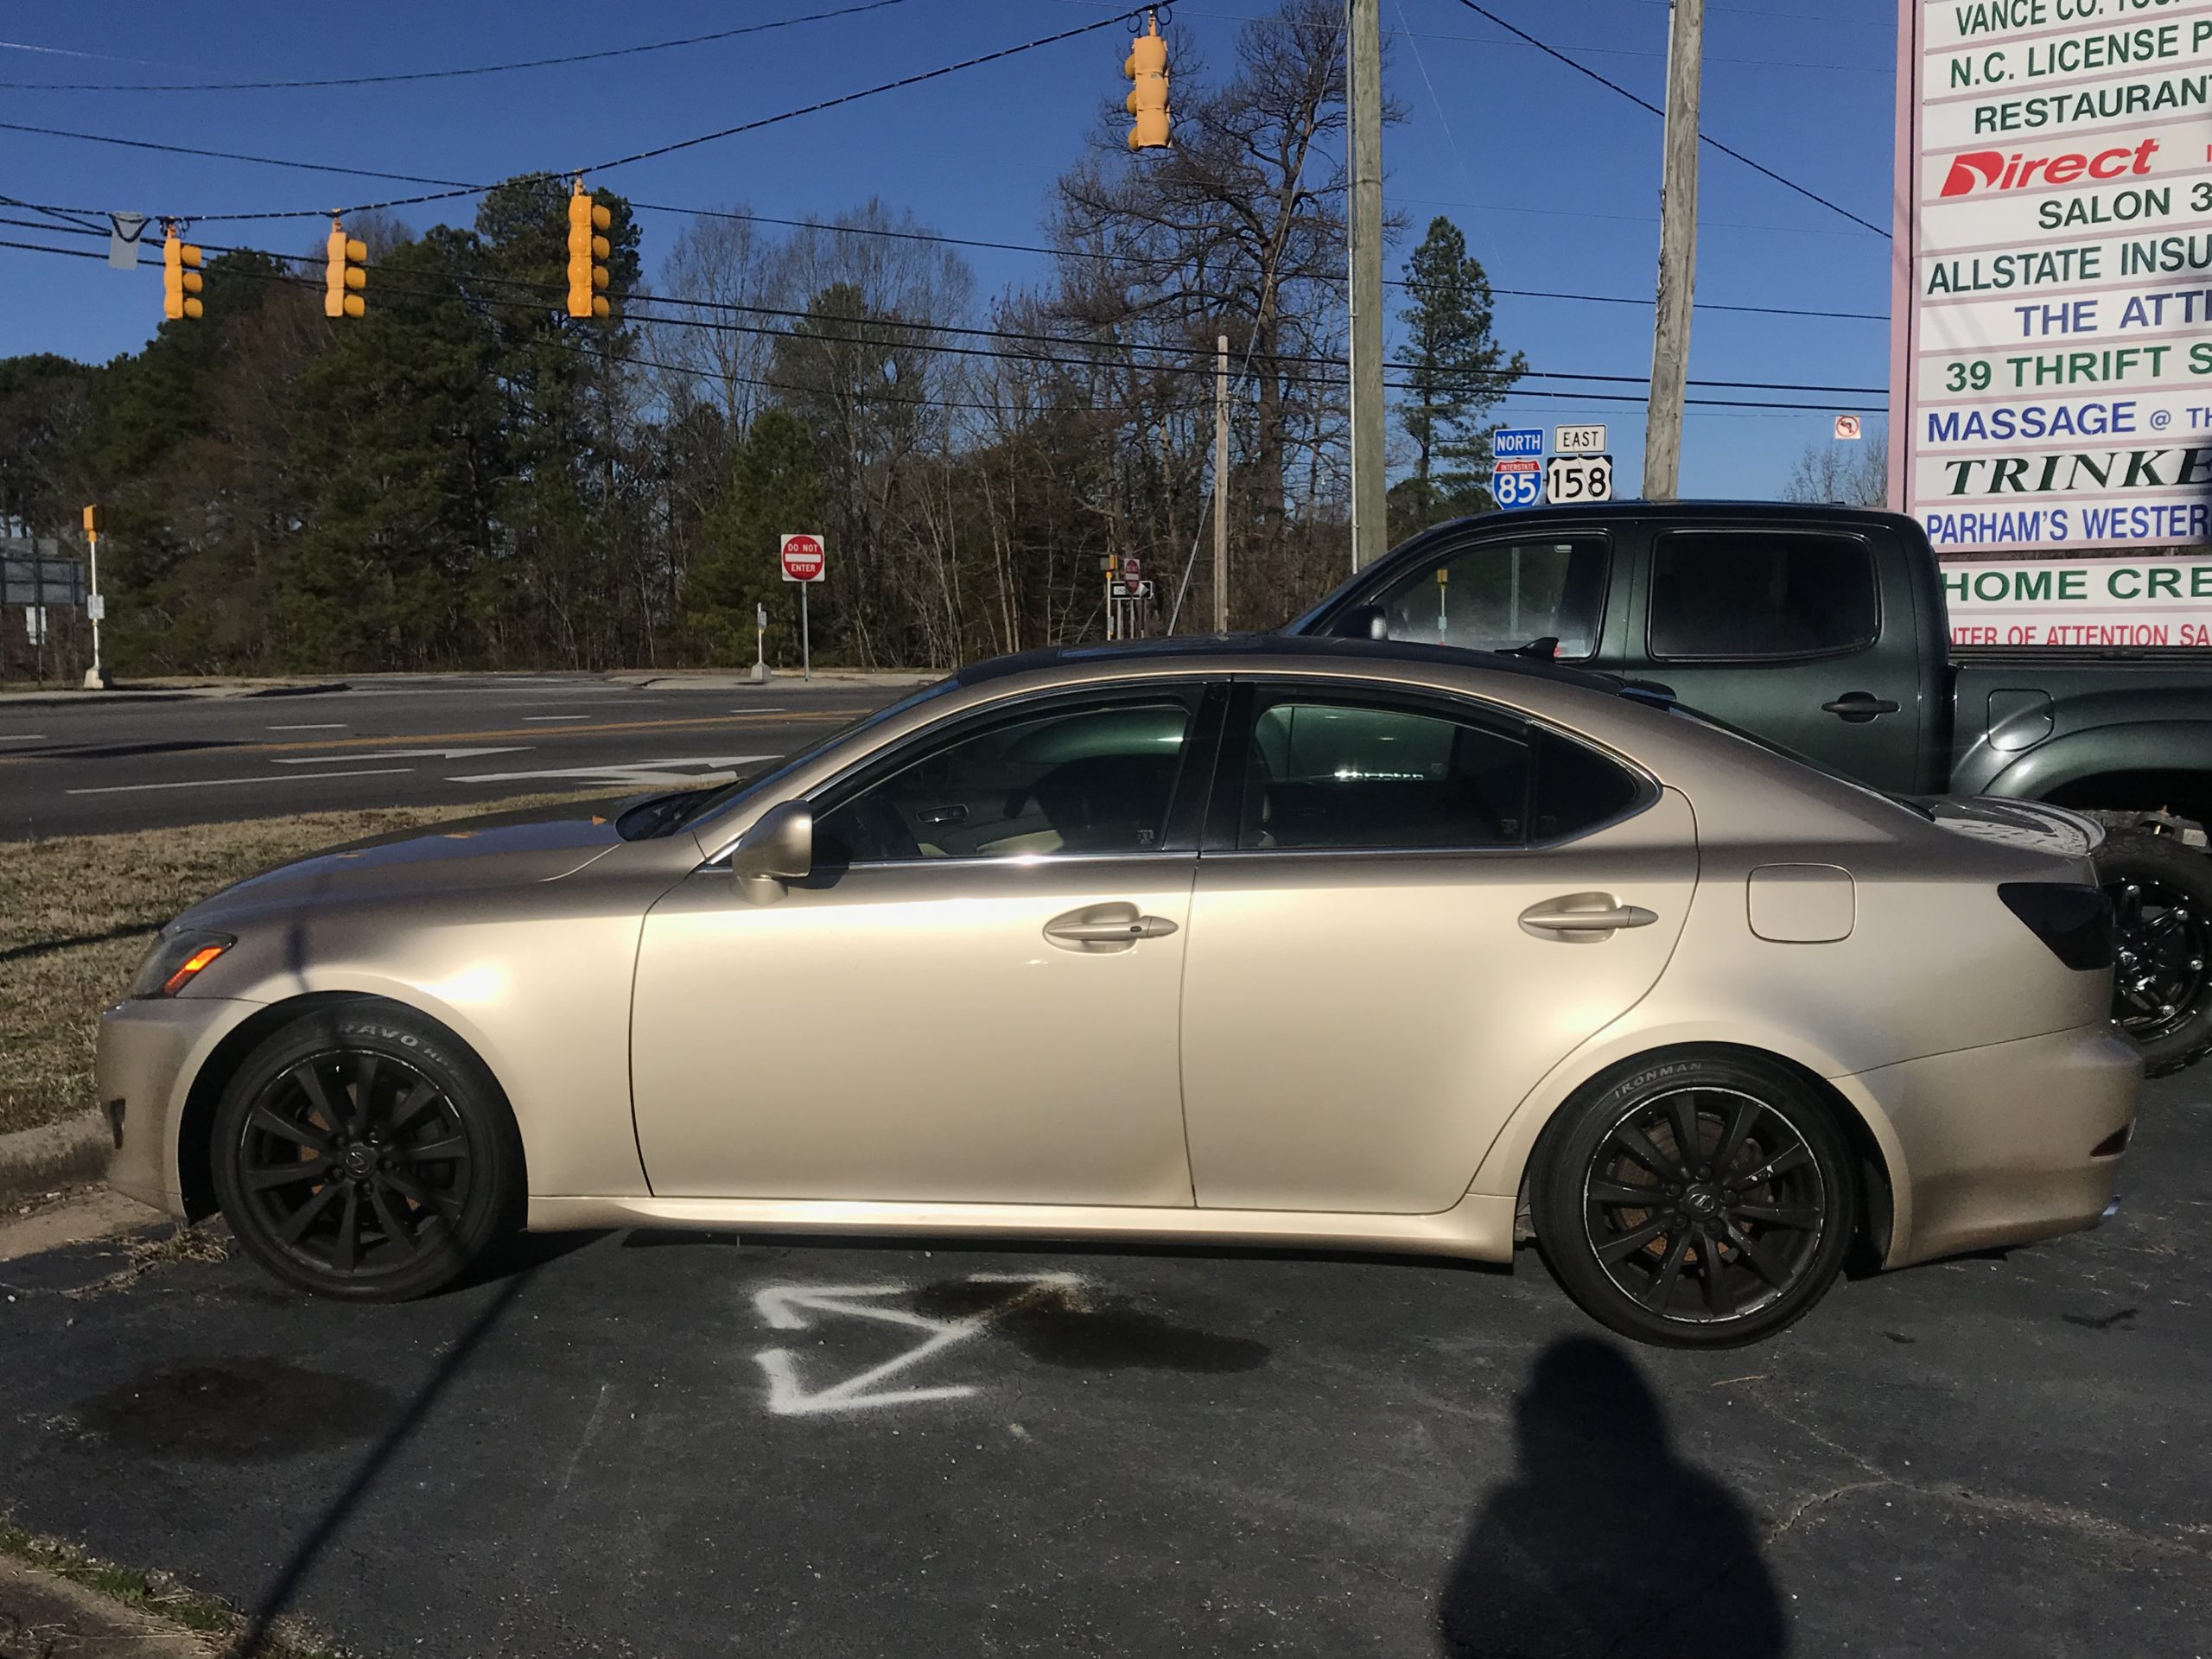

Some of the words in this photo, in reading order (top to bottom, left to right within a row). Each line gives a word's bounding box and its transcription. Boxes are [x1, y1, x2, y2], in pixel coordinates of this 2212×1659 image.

[1955, 0, 2047, 35] VANCE
[1950, 52, 2014, 88] N.C.
[2028, 24, 2179, 77] LICENSE
[1975, 74, 2212, 134] RESTAURAN
[1940, 138, 2160, 198] Direct
[2038, 188, 2171, 229] SALON
[1927, 246, 2102, 295] ALLSTATE
[2120, 234, 2212, 276] INSU
[2015, 300, 2098, 337] THE
[1946, 360, 1992, 391] 39
[2006, 346, 2171, 388] THRIFT
[1928, 401, 2137, 442] MASSAGE
[2150, 410, 2171, 431] @
[1497, 435, 1541, 452] NORTH
[1563, 431, 1599, 448] EAST
[1500, 462, 1535, 471] INTERSTATE
[1554, 467, 1606, 499] 158
[1498, 474, 1536, 504] 85
[1927, 509, 2069, 543] PARHAM'S
[2082, 504, 2209, 542] WESTER
[787, 543, 799, 552] DO
[803, 543, 818, 553] NOT
[791, 563, 816, 573] ENTER
[1940, 570, 2088, 601] HOME
[2107, 567, 2212, 600] CRE
[2007, 626, 2037, 645] OF
[2046, 624, 2169, 646] ATTENTION
[1614, 1063, 1702, 1099] IRONMAN
